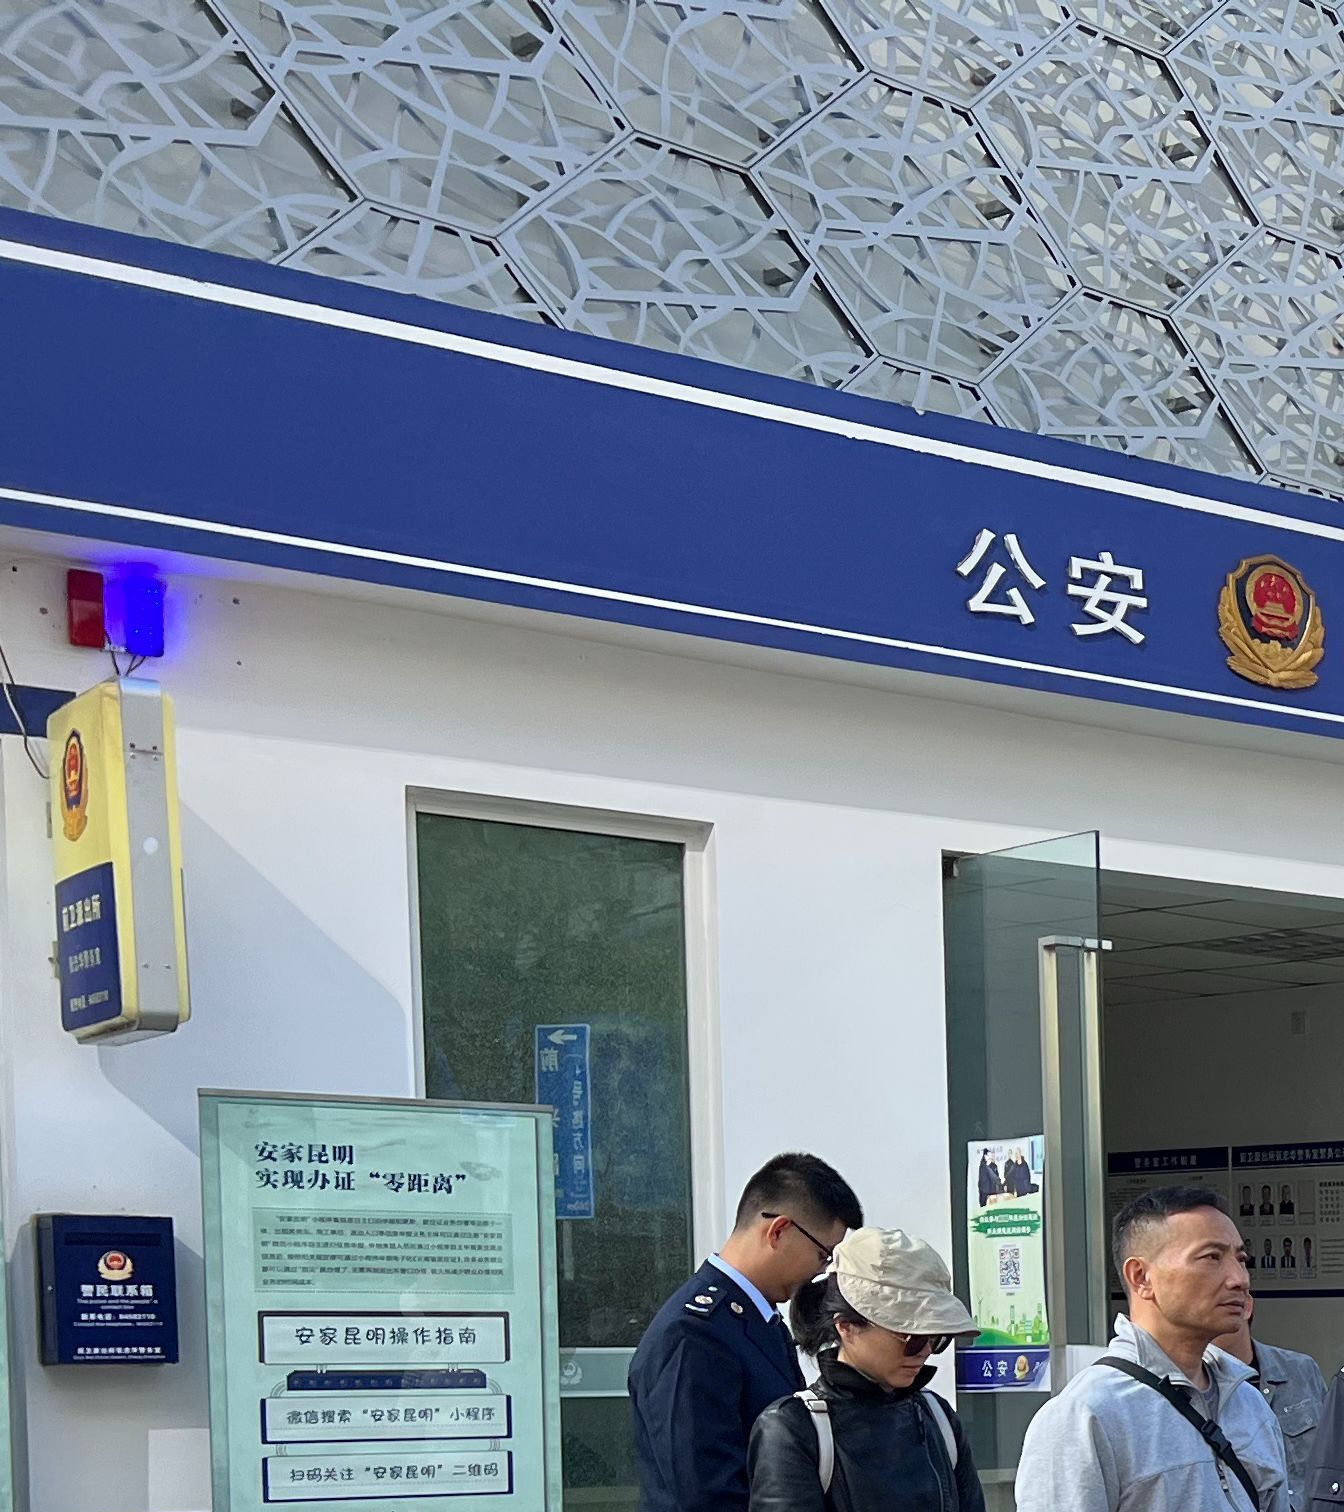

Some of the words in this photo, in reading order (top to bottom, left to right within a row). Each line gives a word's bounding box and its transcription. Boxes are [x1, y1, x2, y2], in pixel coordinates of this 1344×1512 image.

[957, 528, 1147, 645] 公安
[254, 1141, 354, 1165] 安家昆明
[81, 1284, 154, 1297] 警民联系箱
[295, 1326, 476, 1345] 安家昆明操作指南
[981, 1359, 1008, 1377] 公安
